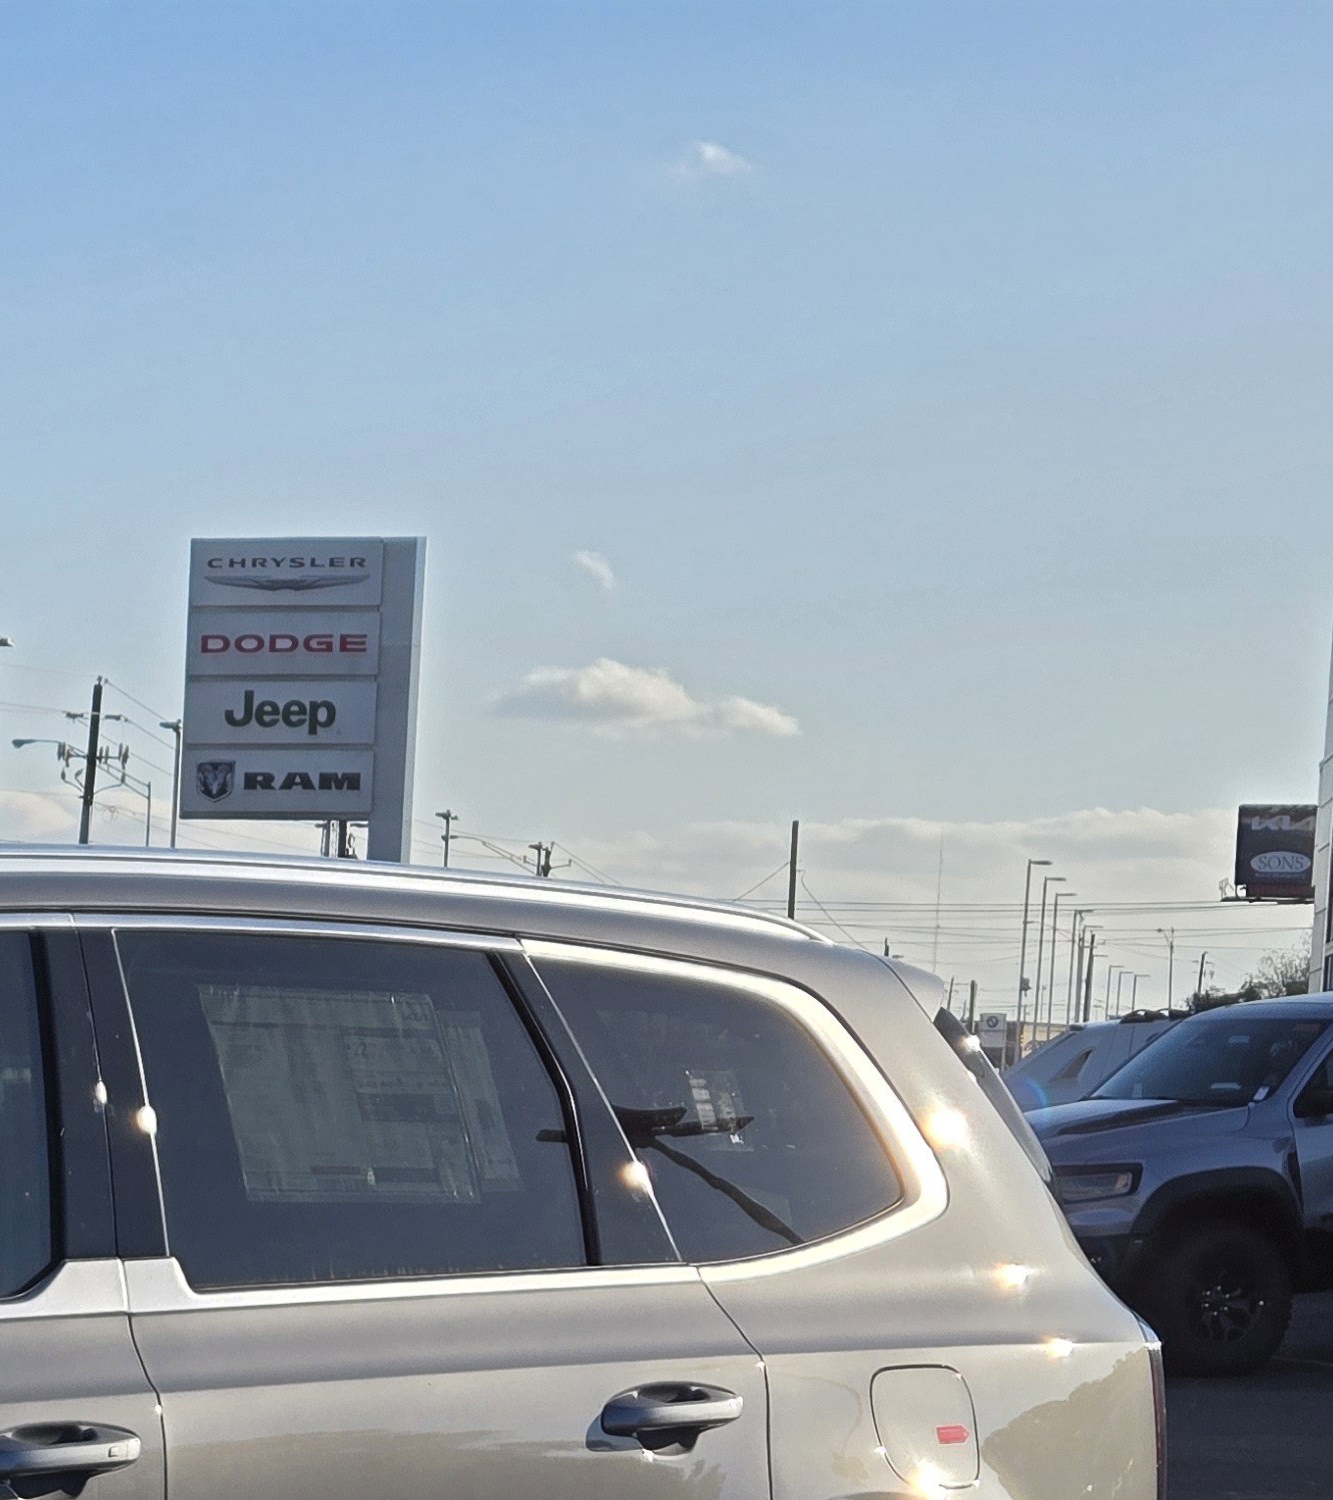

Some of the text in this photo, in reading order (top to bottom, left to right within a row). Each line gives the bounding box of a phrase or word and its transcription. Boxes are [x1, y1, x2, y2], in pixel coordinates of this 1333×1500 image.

[206, 556, 367, 569] CHRYSLER
[200, 633, 368, 654] DODGE
[224, 689, 337, 735] Jeep
[243, 771, 362, 791] RAM
[1257, 855, 1304, 871] SONS
